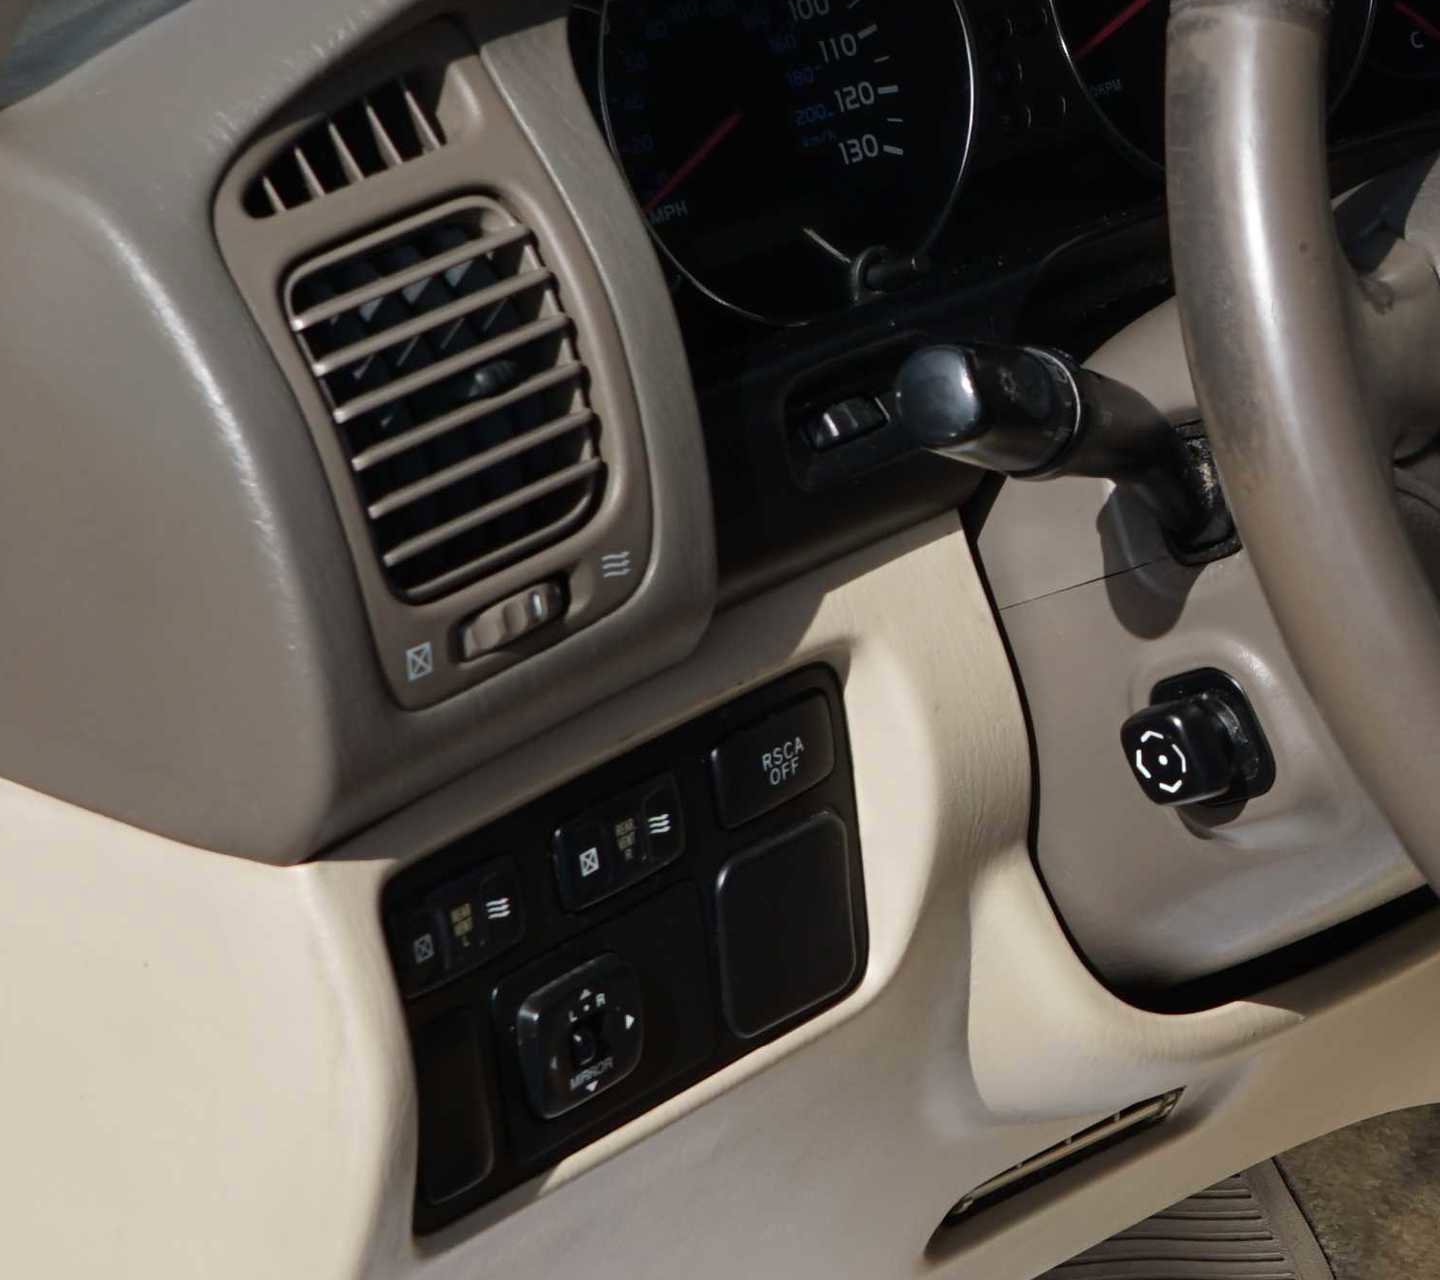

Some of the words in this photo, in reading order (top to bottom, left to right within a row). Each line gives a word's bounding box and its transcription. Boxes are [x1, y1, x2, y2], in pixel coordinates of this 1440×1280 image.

[817, 33, 857, 64] 110
[834, 81, 875, 113] 120
[837, 133, 879, 166] 130
[762, 736, 805, 772] RSCA
[769, 755, 800, 785] OFF
